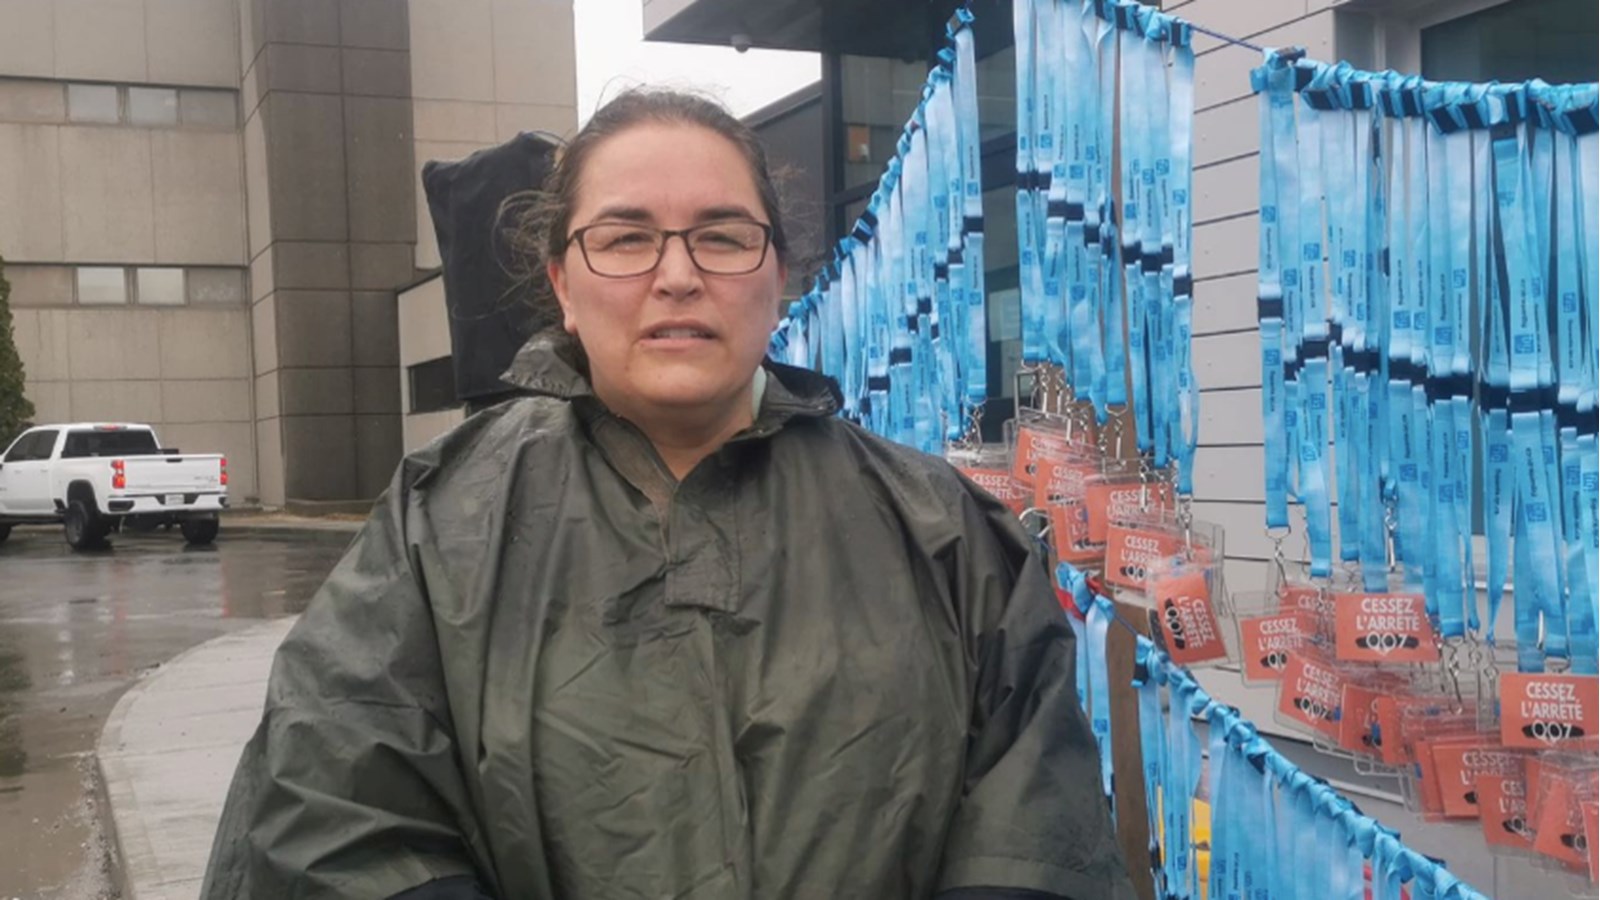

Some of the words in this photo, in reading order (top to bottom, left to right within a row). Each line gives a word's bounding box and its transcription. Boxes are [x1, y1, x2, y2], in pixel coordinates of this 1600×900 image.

[1110, 489, 1152, 502] CESSZ
[1125, 535, 1159, 551] CESSEZ
[1361, 598, 1414, 614] CESSEZ
[1192, 599, 1216, 643] CESSEZ
[1260, 618, 1298, 635] CESSEZ
[1365, 631, 1408, 651] 007
[1267, 651, 1288, 669] 00
[1303, 663, 1340, 685] CESSEZ
[1526, 681, 1576, 701] CESSEZ
[1531, 720, 1572, 741] 007
